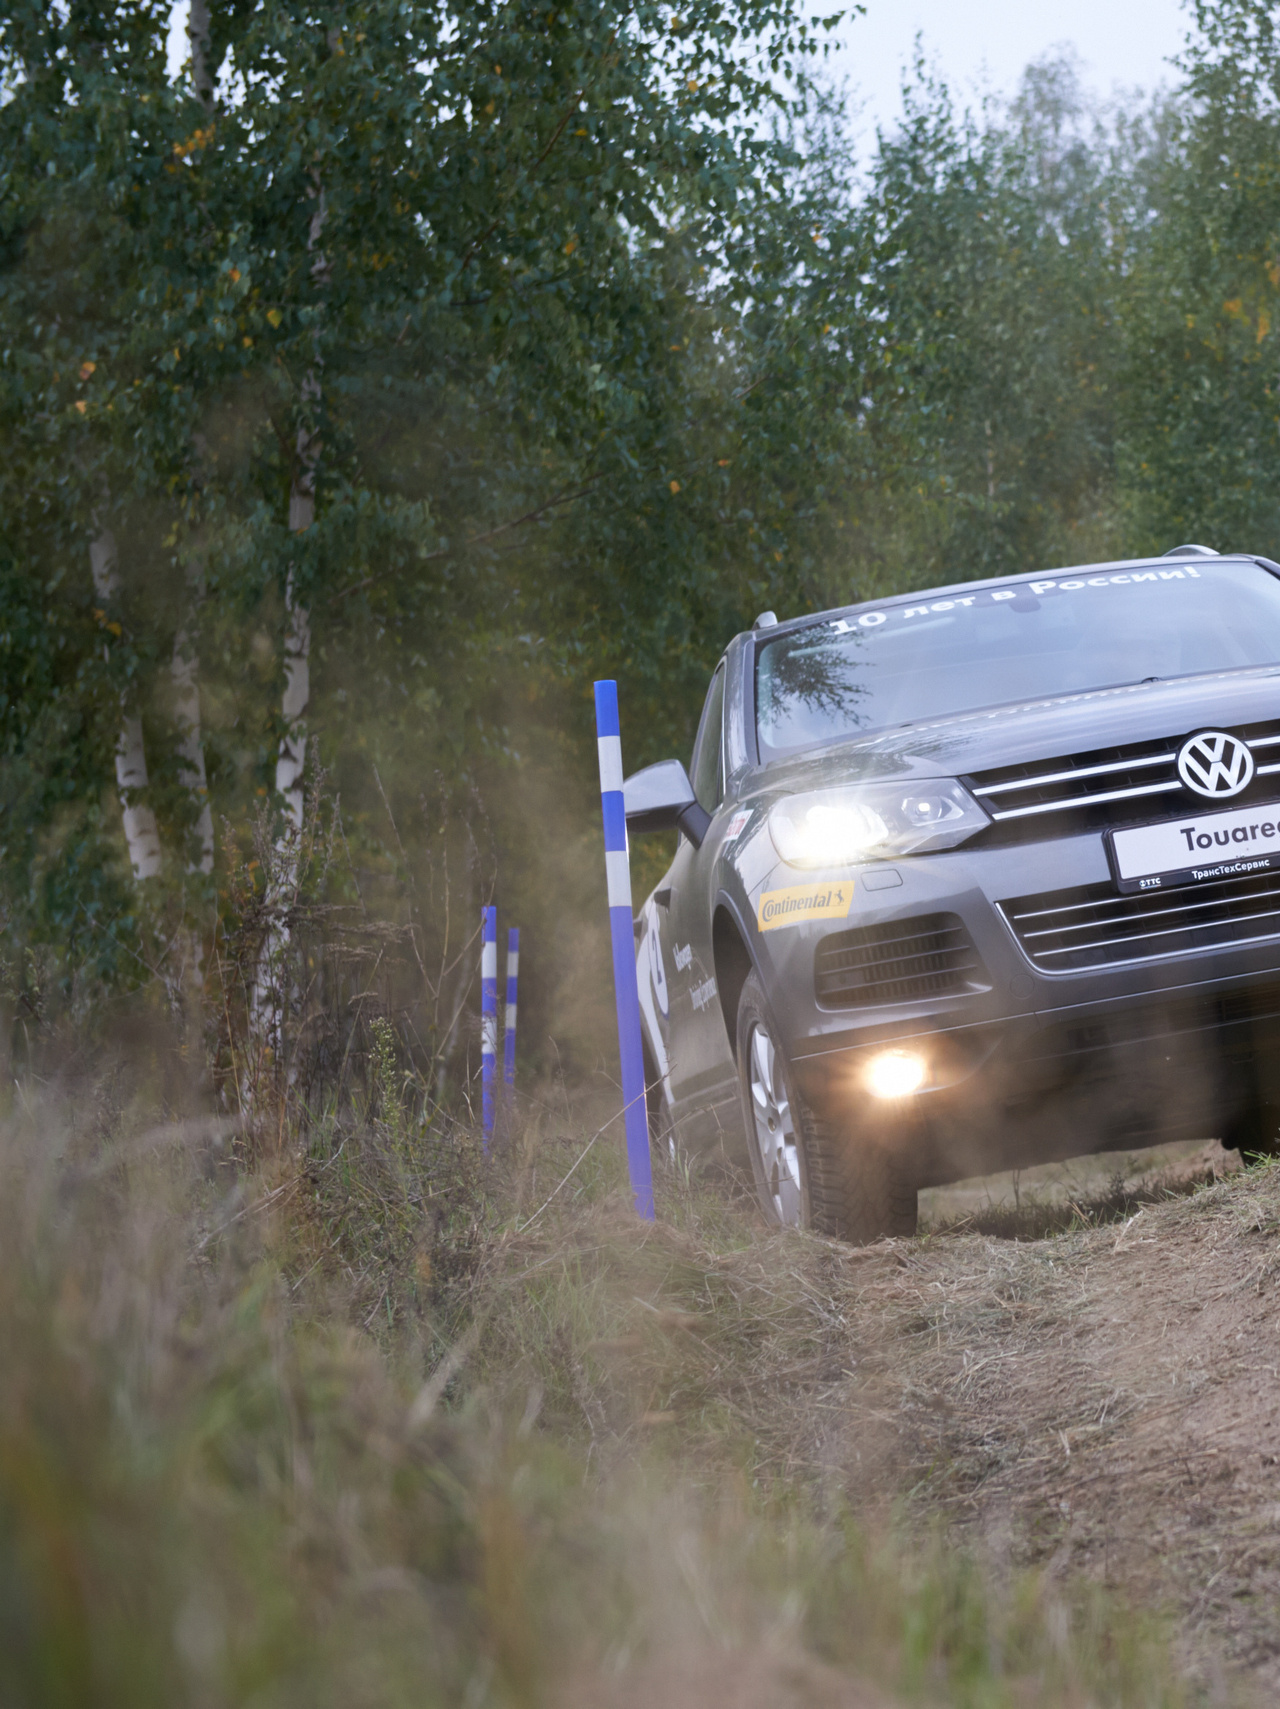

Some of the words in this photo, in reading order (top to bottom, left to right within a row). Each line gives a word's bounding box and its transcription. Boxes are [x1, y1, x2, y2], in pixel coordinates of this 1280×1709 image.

[829, 611, 887, 635] 10
[903, 596, 976, 619] лет
[1028, 566, 1201, 595] России!
[1191, 859, 1271, 880] ТрансТехСервис
[762, 891, 832, 922] Continental
